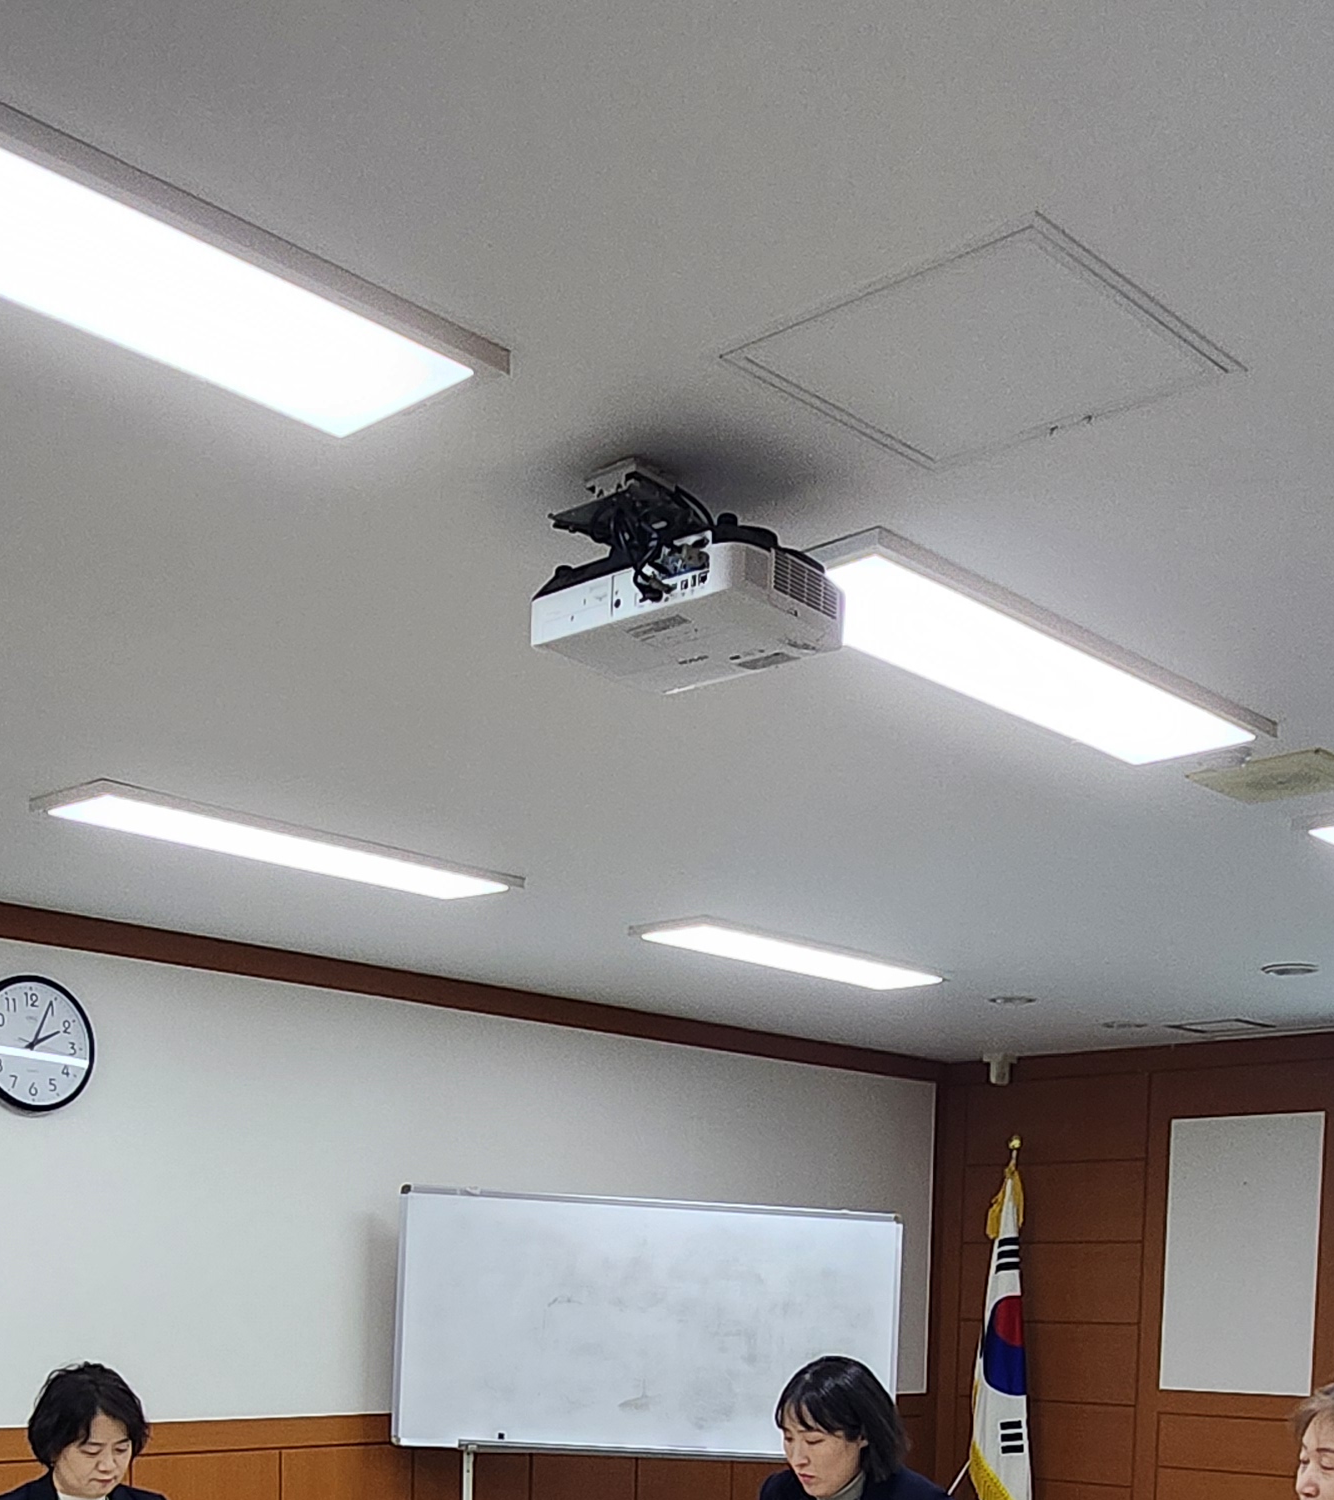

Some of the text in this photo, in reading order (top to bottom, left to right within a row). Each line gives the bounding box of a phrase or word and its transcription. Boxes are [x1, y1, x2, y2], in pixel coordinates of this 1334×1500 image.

[5, 997, 17, 1013] 11
[23, 991, 39, 1008] 12
[62, 1019, 72, 1035] 2
[68, 1041, 77, 1056] 3
[9, 1074, 18, 1089] 7
[48, 1078, 57, 1092] 5
[28, 1082, 38, 1097] 6
